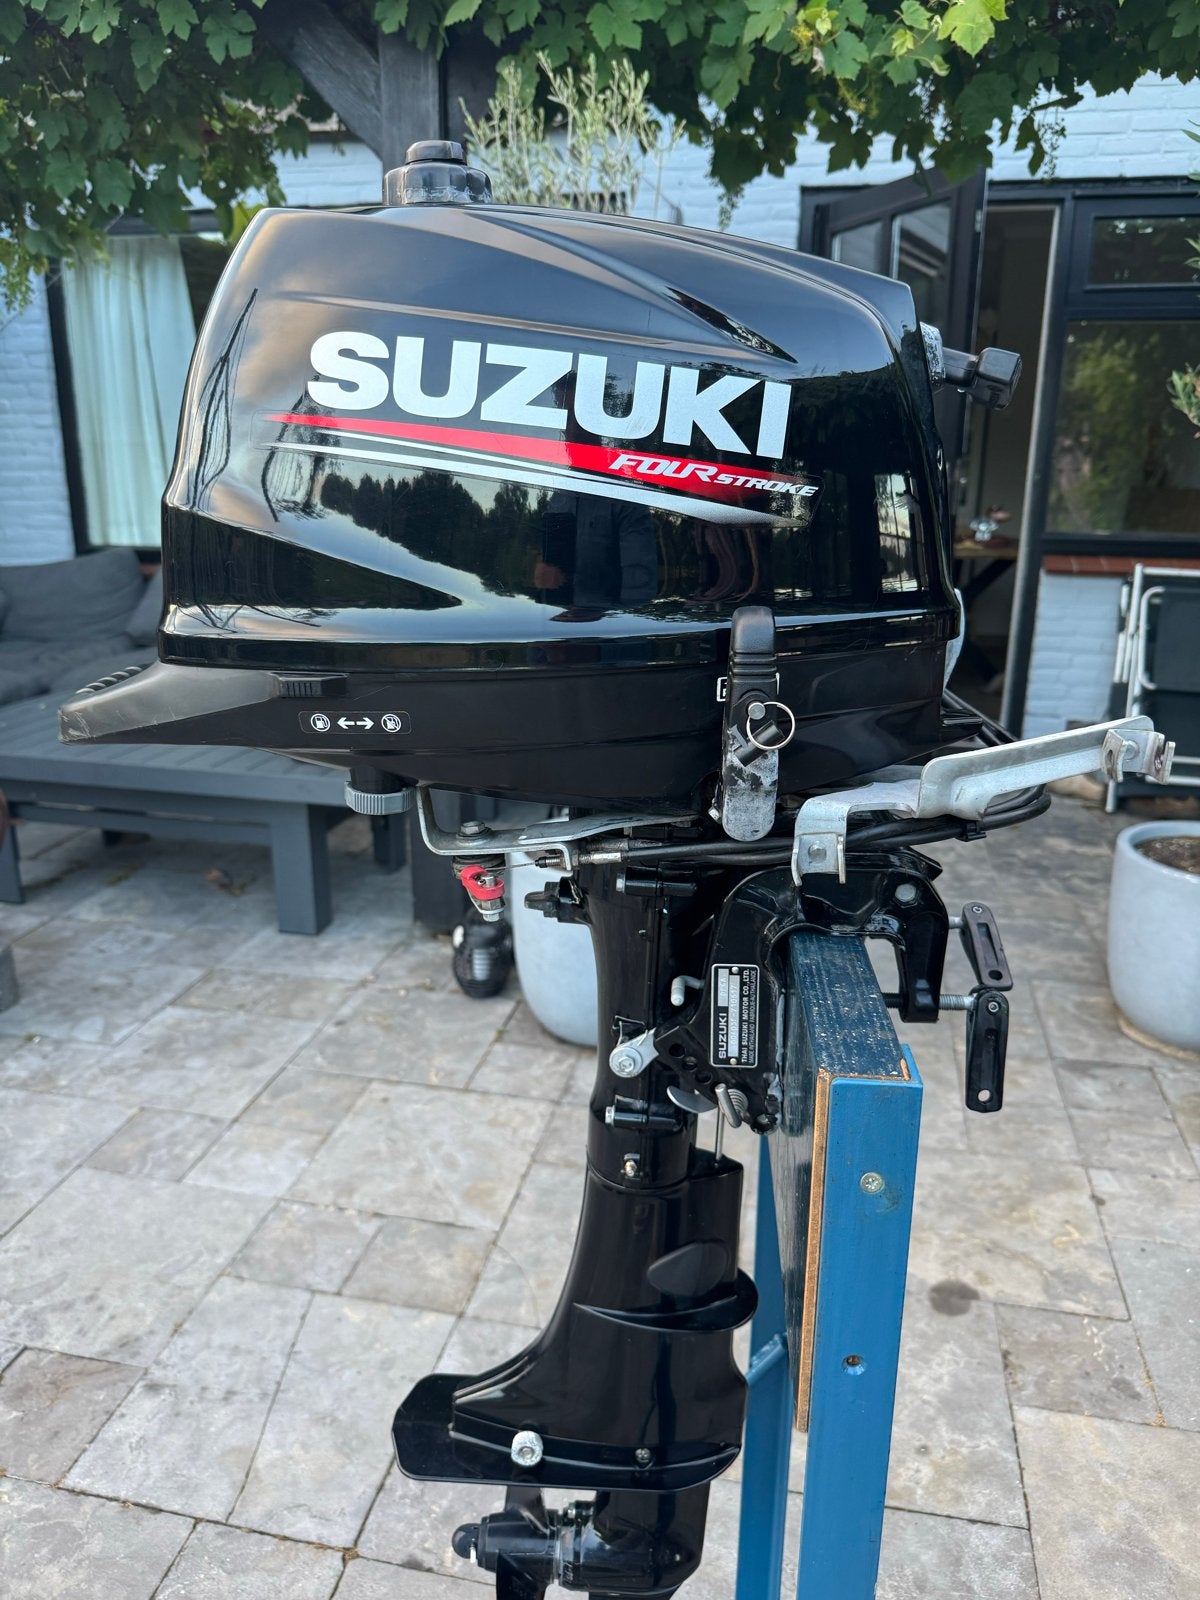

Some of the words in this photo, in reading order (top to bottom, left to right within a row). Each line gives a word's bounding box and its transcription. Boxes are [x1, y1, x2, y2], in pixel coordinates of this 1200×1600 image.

[306, 330, 793, 460] SUZUKI
[609, 453, 718, 483] FOUR
[714, 473, 819, 497] STROKE
[718, 1013, 727, 1059] SUZUKI
